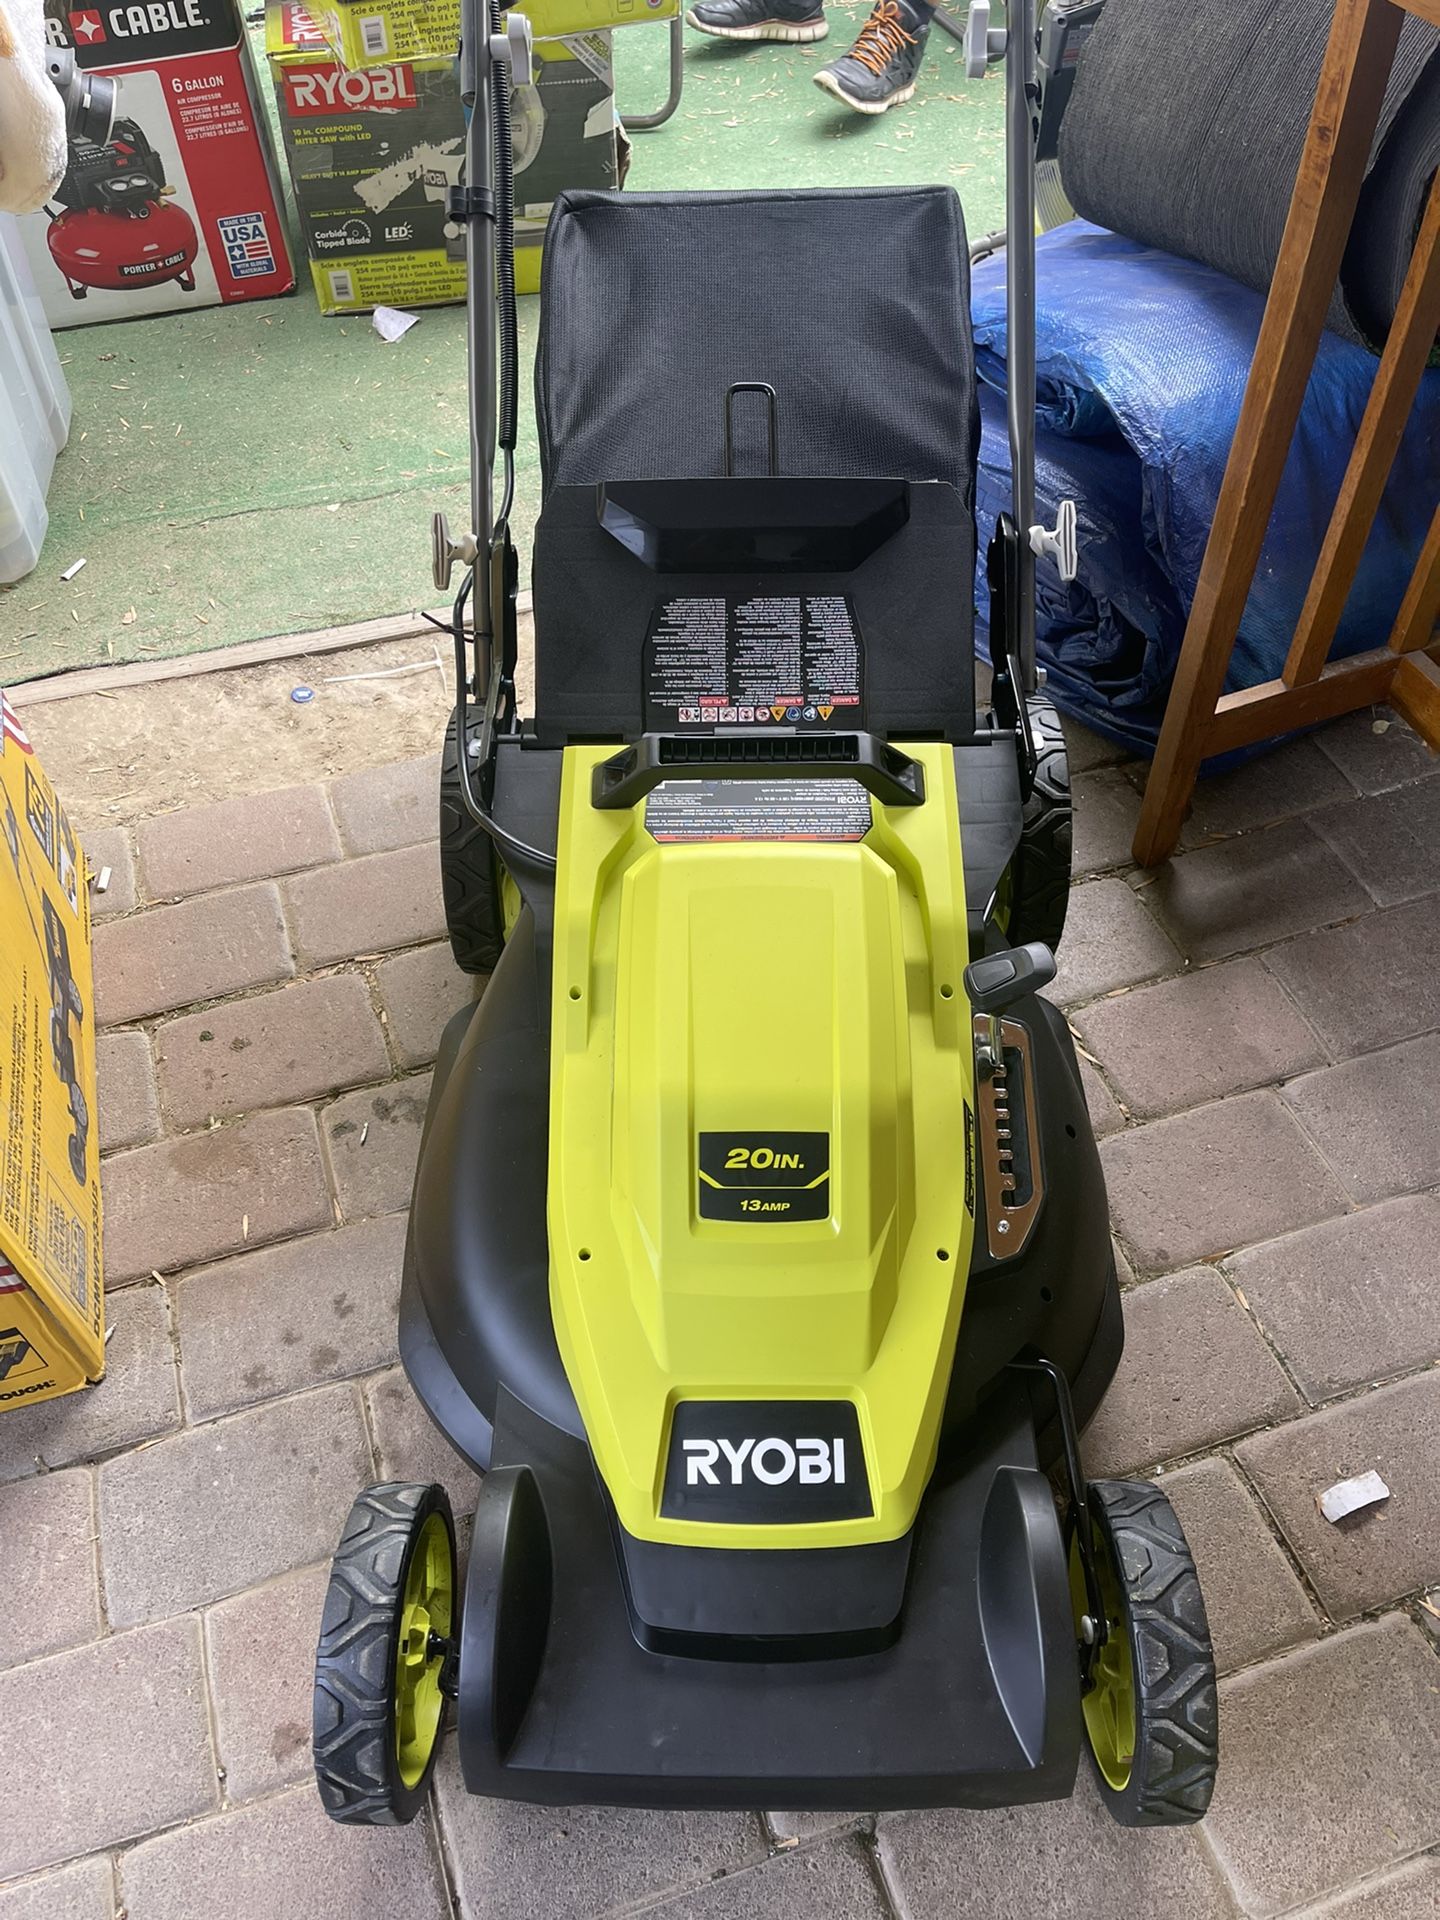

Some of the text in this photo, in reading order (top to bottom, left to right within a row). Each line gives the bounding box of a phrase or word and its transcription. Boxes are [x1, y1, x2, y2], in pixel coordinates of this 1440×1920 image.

[352, 7, 366, 16] Scie
[376, 0, 405, 12] onglets
[390, 11, 404, 20] 254
[172, 75, 224, 93] 6 GALLON
[288, 67, 406, 106] RYOBI
[187, 93, 222, 103] COMPRESSOR
[315, 124, 363, 134] COMPOUND
[223, 225, 264, 243] USA
[315, 229, 347, 239] Carbide
[385, 226, 408, 238] LED
[317, 239, 345, 249] Tipped
[124, 252, 184, 275] PORTER CABLE
[724, 1148, 804, 1169] 20IN.
[740, 1200, 790, 1211] 13AMP
[682, 1438, 846, 1485] RYOBI
